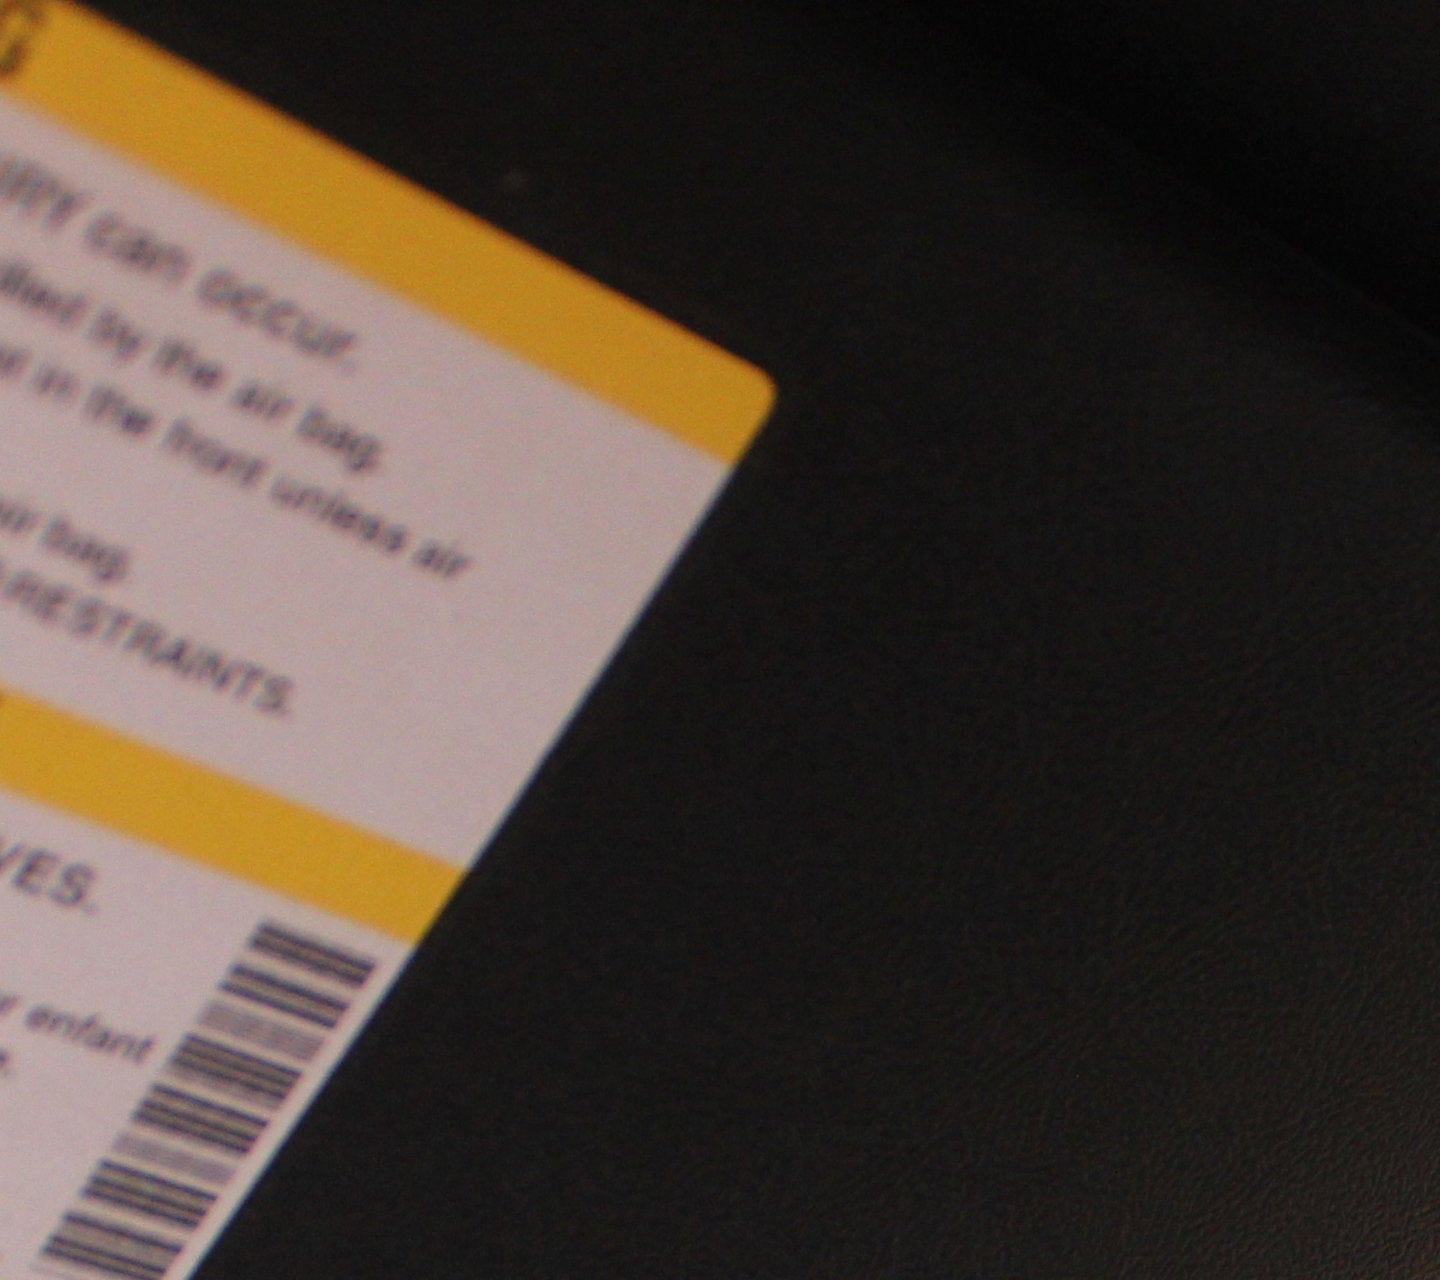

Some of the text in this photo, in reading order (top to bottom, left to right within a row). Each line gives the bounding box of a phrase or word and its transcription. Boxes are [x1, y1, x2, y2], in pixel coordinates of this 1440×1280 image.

[87, 216, 189, 278] can
[198, 271, 366, 364] occur.
[31, 365, 80, 401] in
[87, 388, 155, 438] the
[166, 420, 268, 489] front
[273, 483, 408, 555] unless
[413, 543, 470, 578] air
[155, 340, 225, 392] the
[232, 383, 294, 421] air
[299, 408, 380, 475] bag.
[44, 519, 129, 585] bag.
[25, 1006, 155, 1064] enfant
